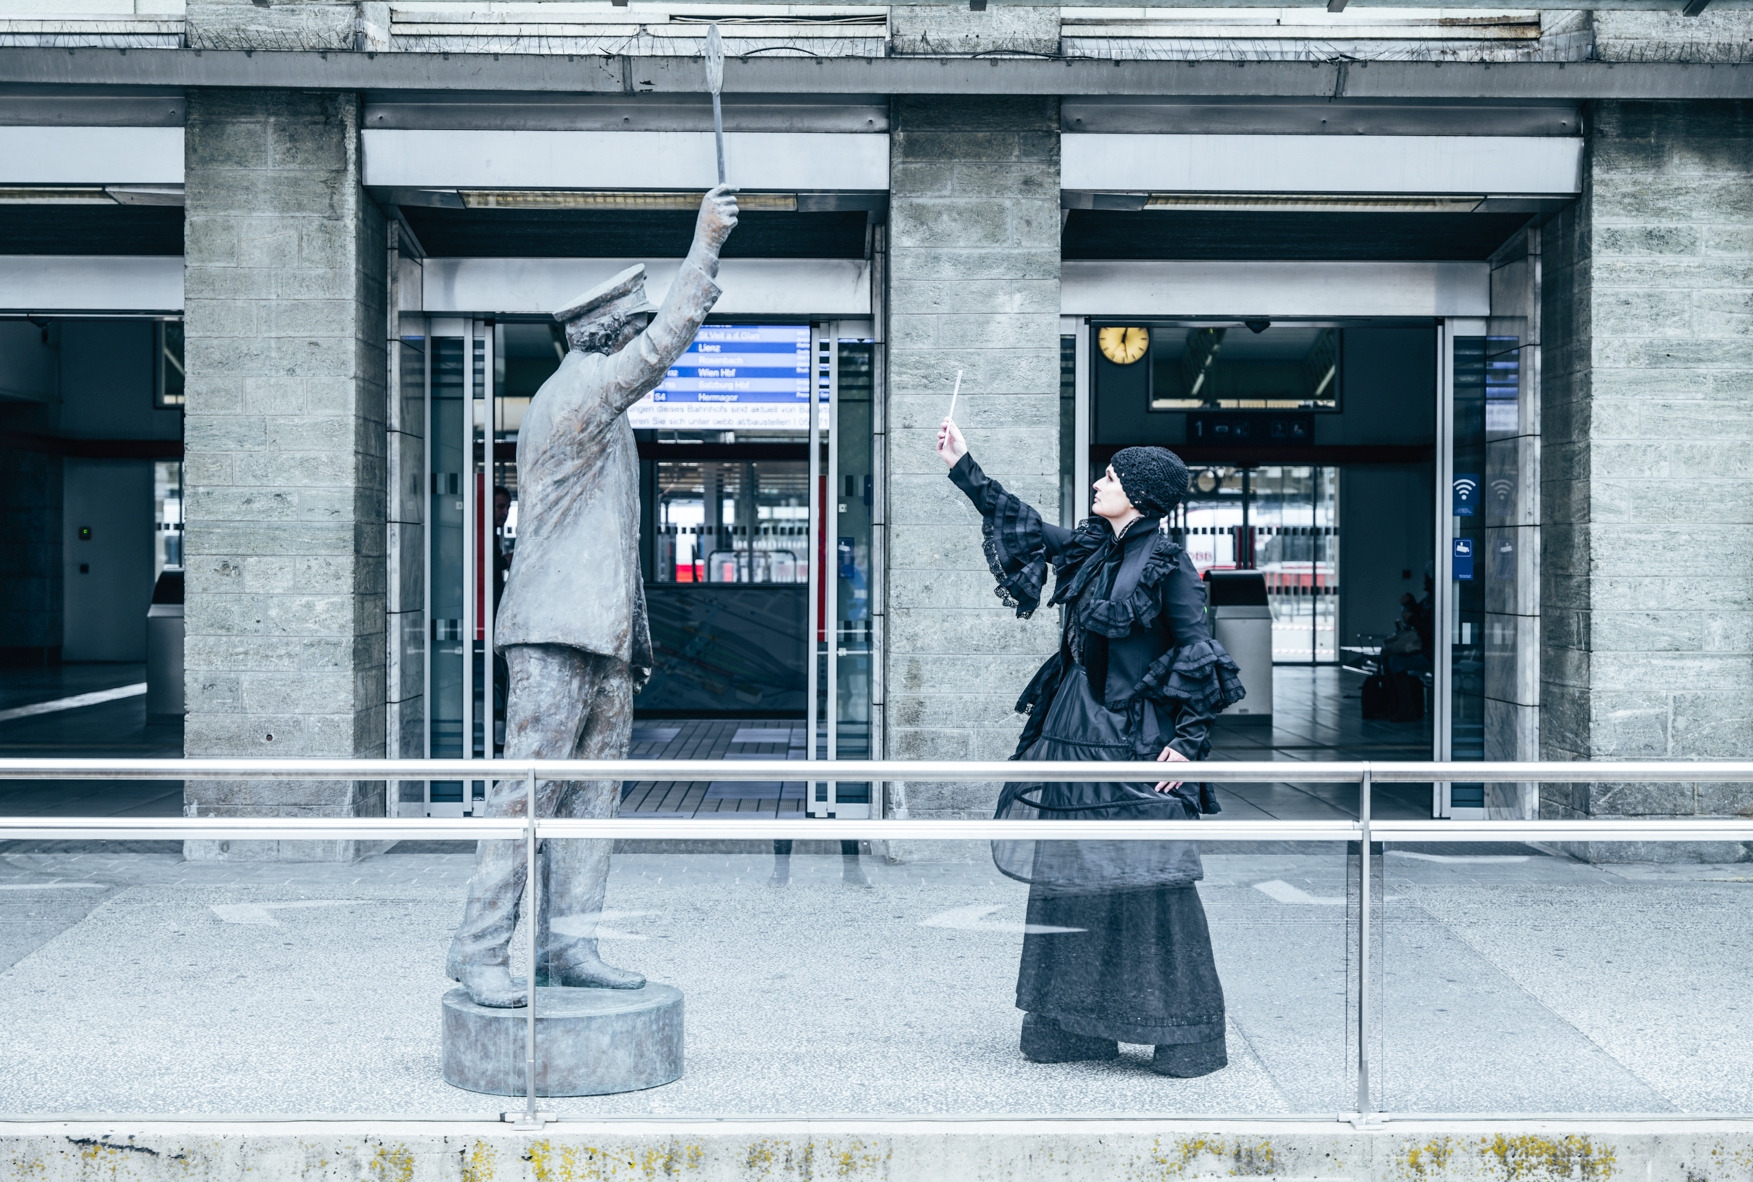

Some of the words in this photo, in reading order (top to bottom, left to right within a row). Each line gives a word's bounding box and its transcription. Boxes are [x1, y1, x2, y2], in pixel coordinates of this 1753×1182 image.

[698, 343, 721, 353] Lienz
[698, 355, 744, 365] Rosenbach
[698, 368, 719, 377] Wien
[720, 368, 736, 377] Hbf
[698, 380, 734, 390] Salzburg
[734, 380, 750, 389] Hbf
[654, 393, 666, 401] S4
[698, 393, 739, 402] Hermagor
[657, 405, 684, 413] dieses
[687, 404, 727, 413] Bahnhofs
[751, 405, 778, 413] aktuell
[652, 416, 666, 425] Sie
[669, 417, 685, 425] sich
[688, 417, 710, 425] unter
[1195, 421, 1203, 437] 1
